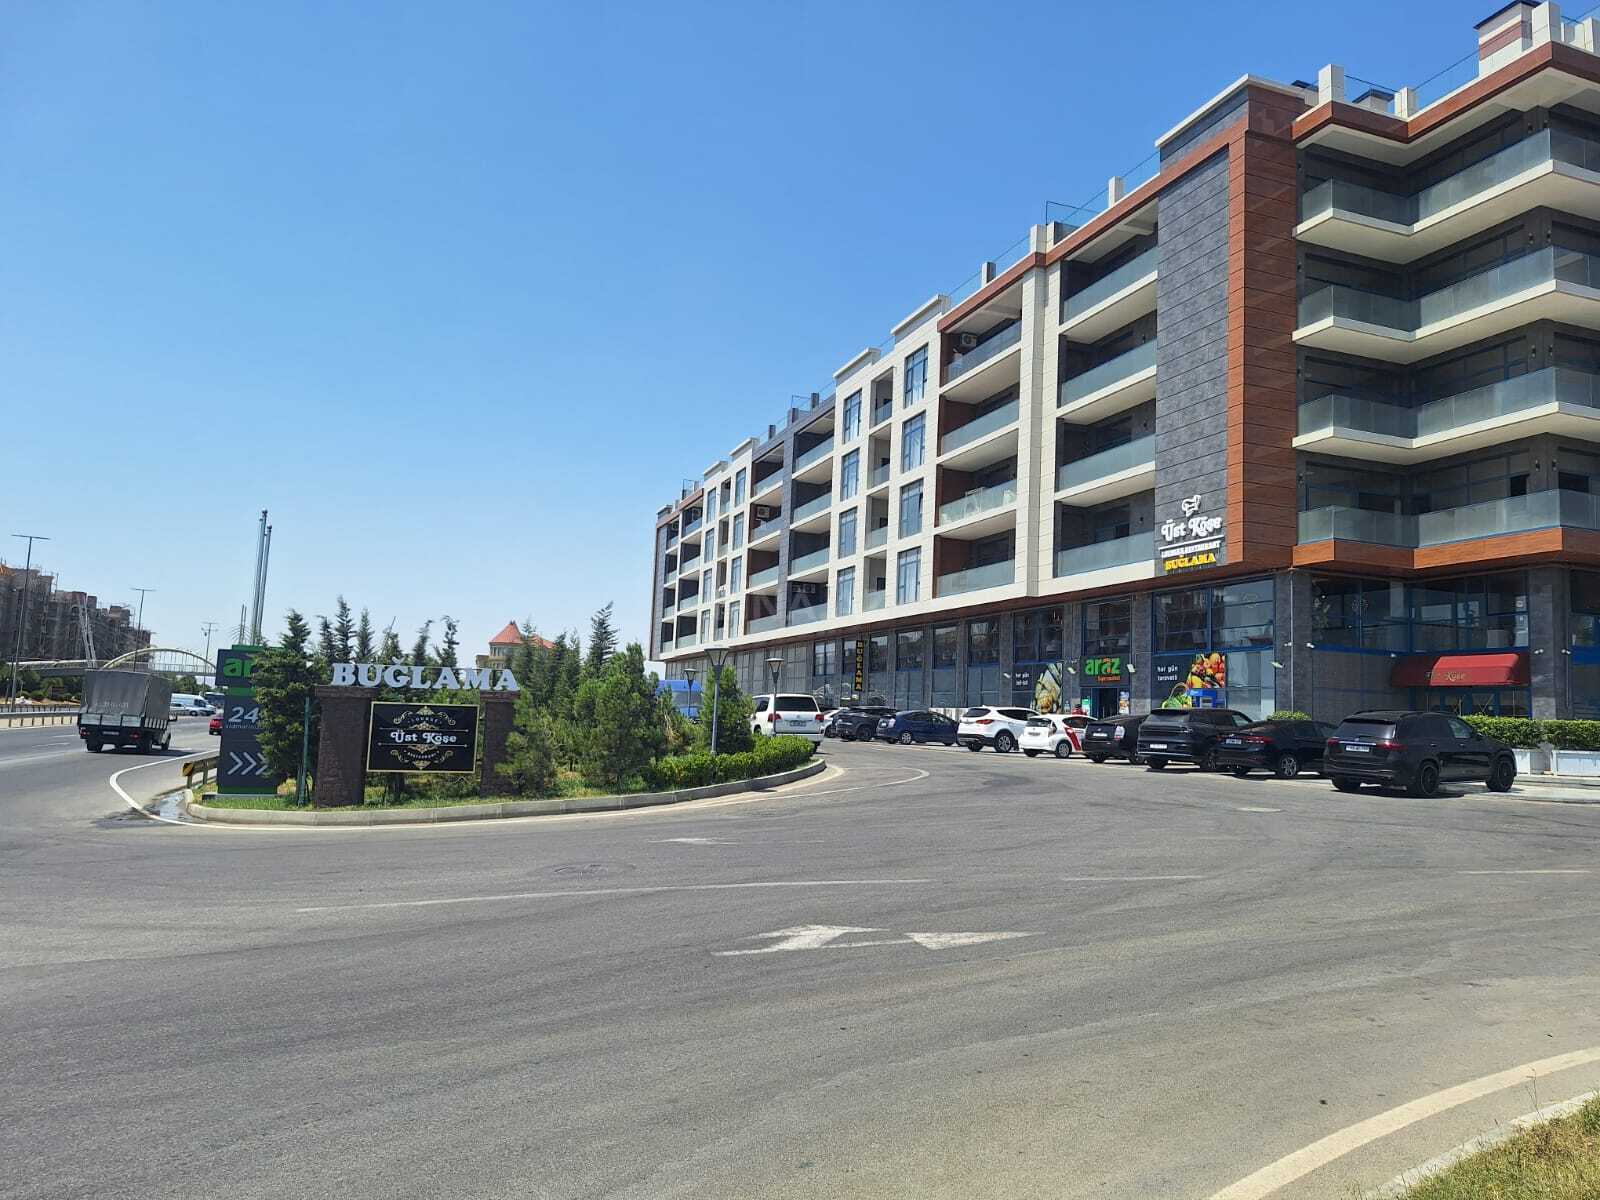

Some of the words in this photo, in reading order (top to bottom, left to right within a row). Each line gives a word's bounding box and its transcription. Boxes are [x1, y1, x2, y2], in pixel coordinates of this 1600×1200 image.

[223, 657, 257, 678] ar
[331, 657, 520, 691] BUĞLAMA
[1084, 657, 1120, 676] araz
[228, 706, 259, 722] 24
[390, 730, 418, 743] Üst
[422, 731, 457, 745] Köşe
